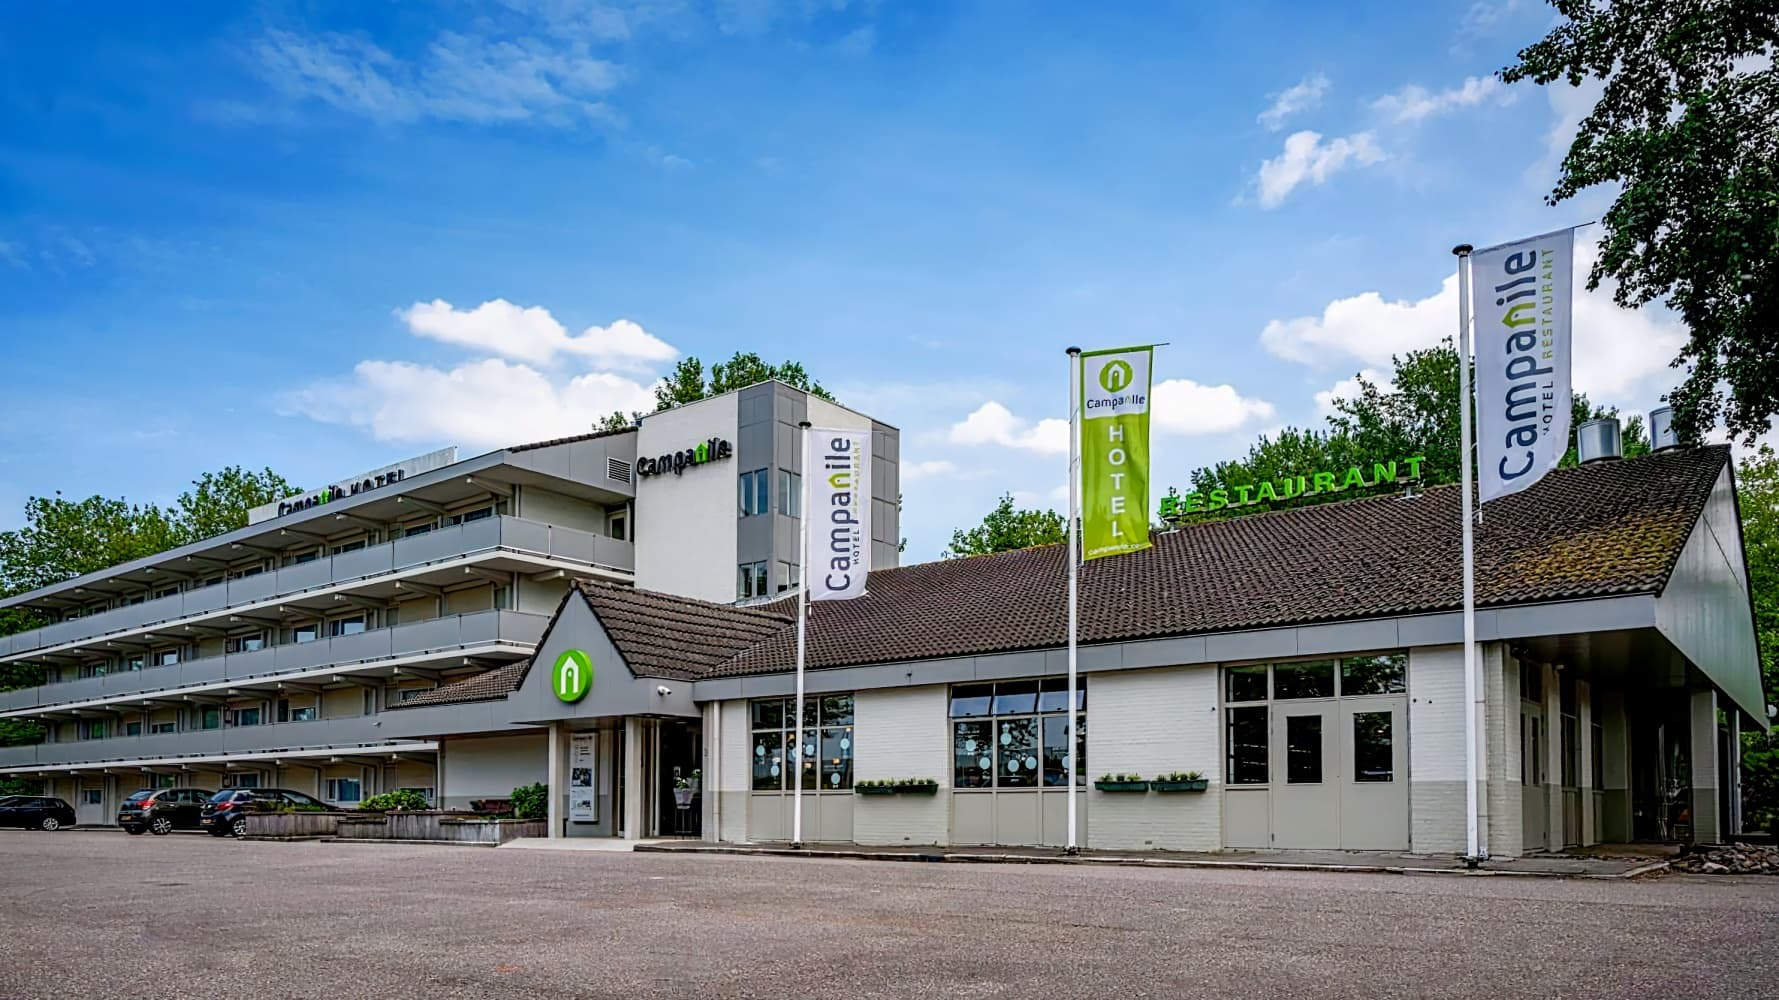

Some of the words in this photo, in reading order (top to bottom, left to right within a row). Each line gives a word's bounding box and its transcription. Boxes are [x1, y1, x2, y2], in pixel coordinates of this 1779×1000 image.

[1540, 248, 1554, 360] RESTAURANT
[1494, 249, 1553, 481] Campanile
[636, 437, 733, 477] Campanile
[1107, 424, 1127, 538] HOTEL
[1159, 455, 1427, 517] RESTAURANT
[825, 437, 860, 592] Campanile
